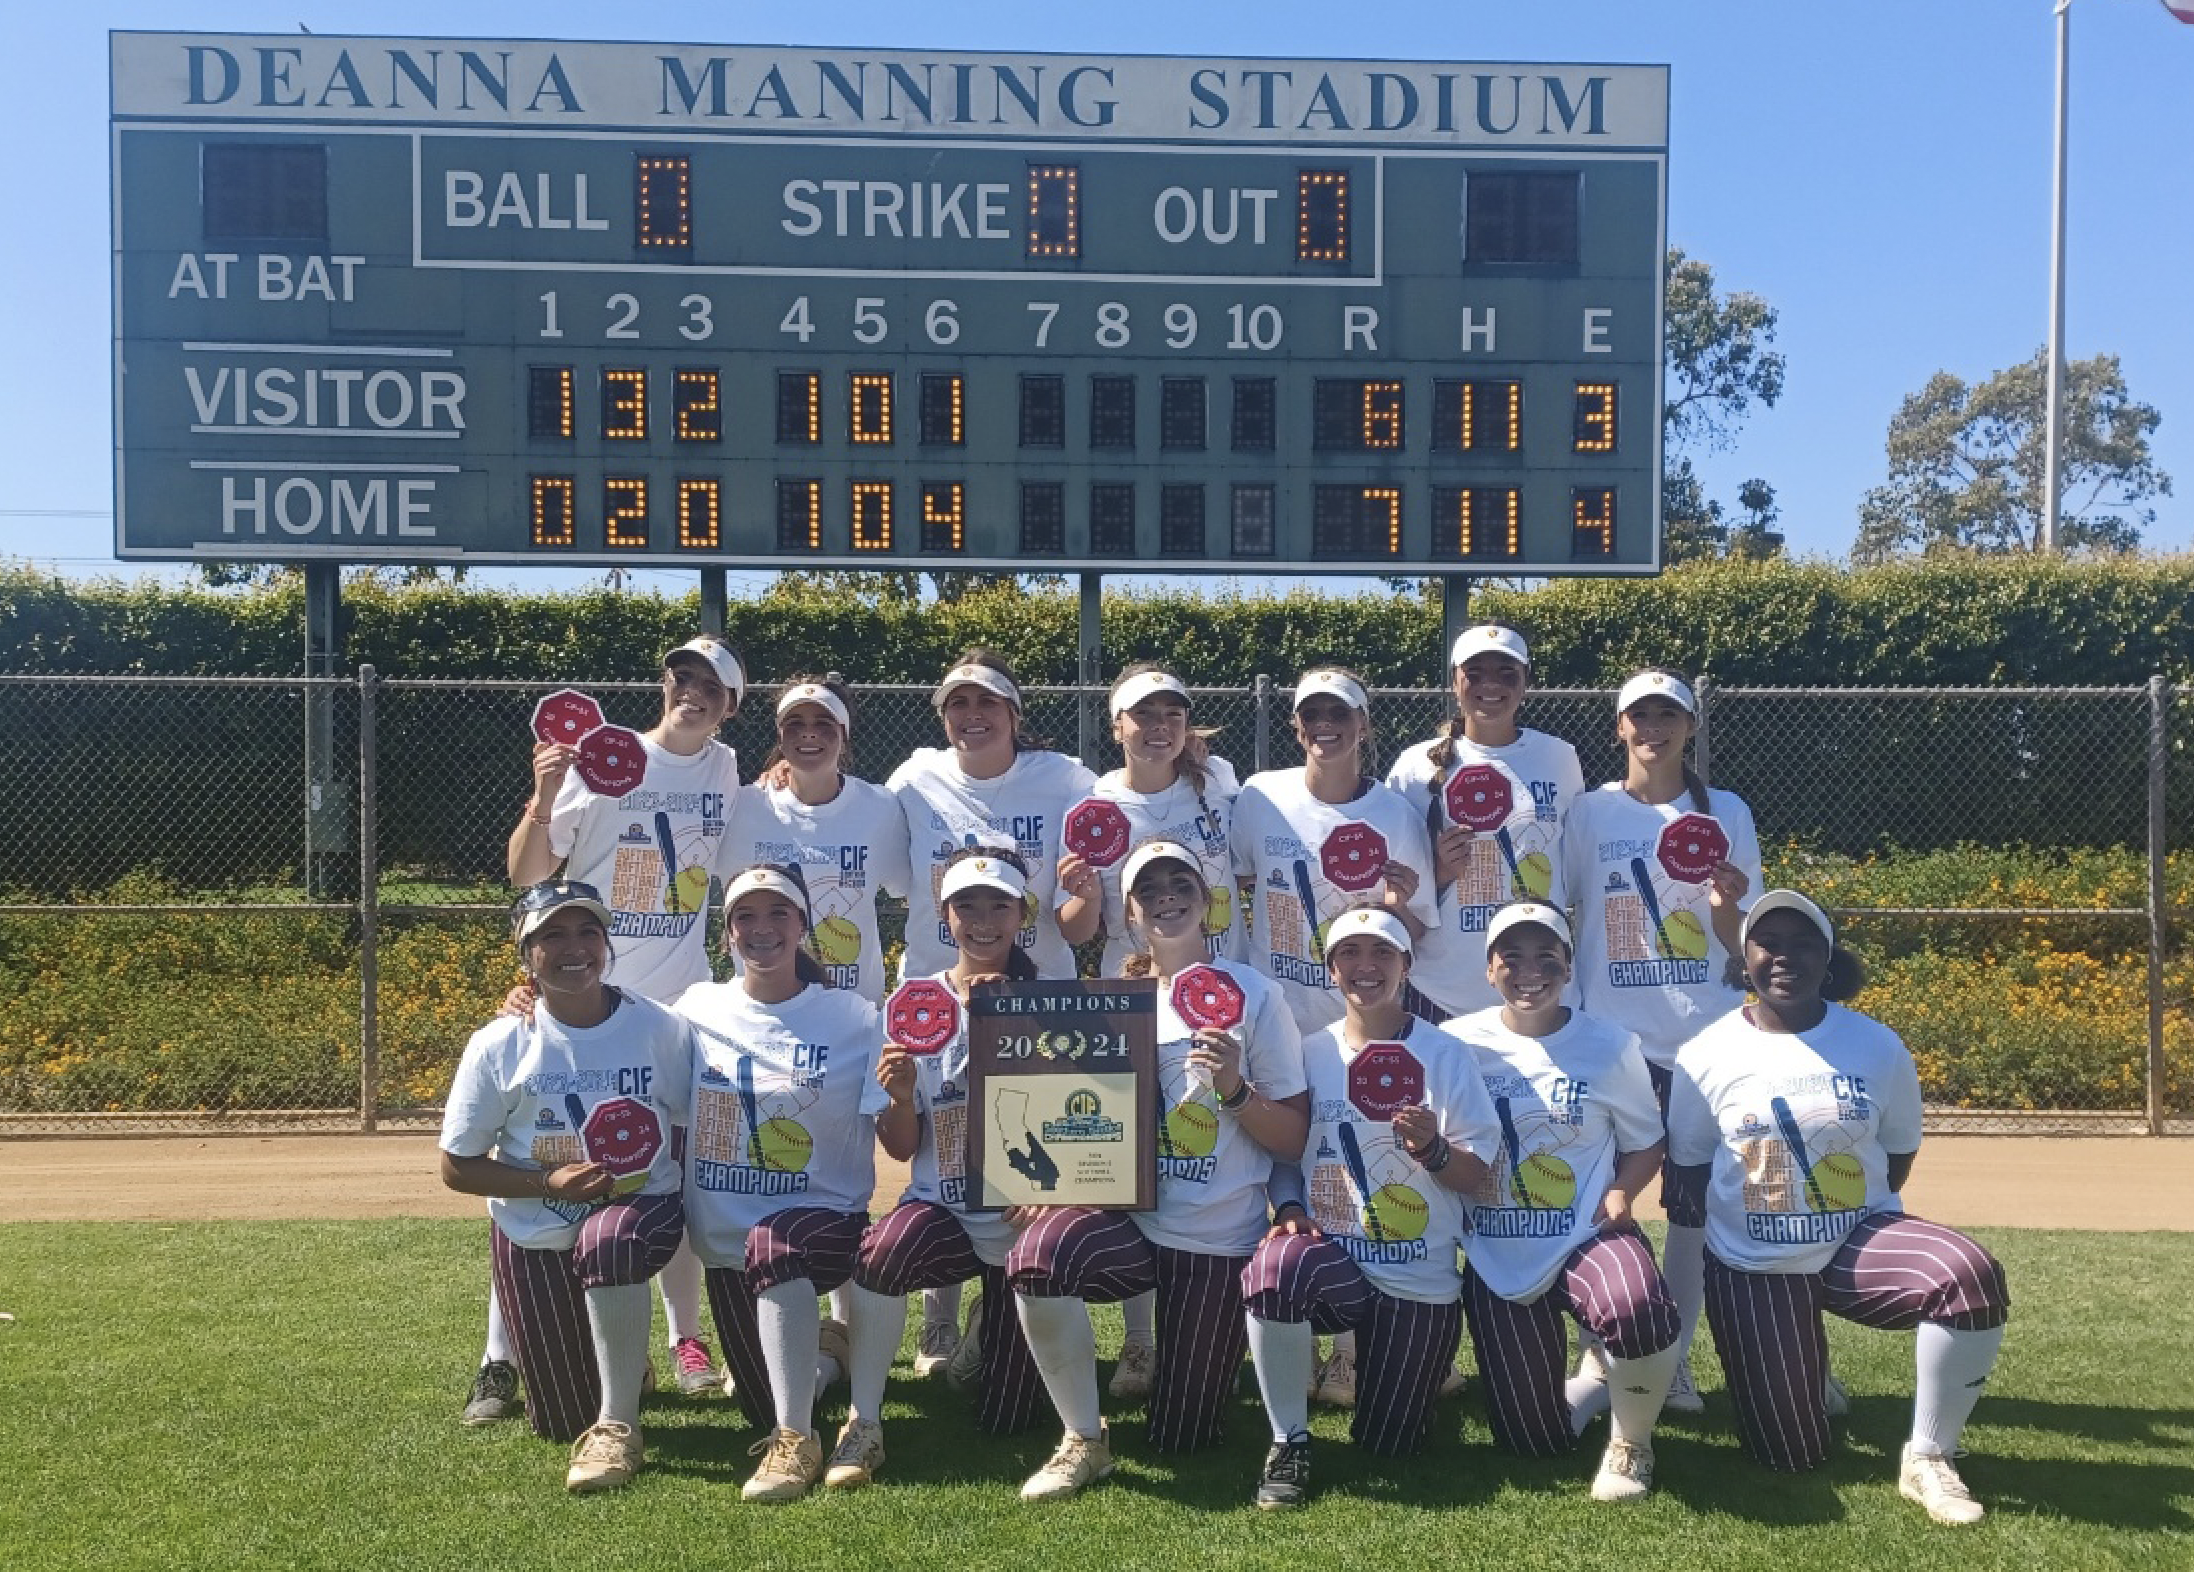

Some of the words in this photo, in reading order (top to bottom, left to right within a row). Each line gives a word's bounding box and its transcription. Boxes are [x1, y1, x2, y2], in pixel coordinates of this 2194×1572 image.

[183, 46, 585, 113] DEANNA
[657, 55, 1119, 126] MANNING
[1190, 70, 1612, 134] STADIUM
[446, 171, 609, 230] BALL
[639, 159, 690, 247] 0
[781, 180, 1010, 239] STRIKE
[1030, 167, 1077, 255] 0
[1155, 187, 1278, 244] OUT
[1300, 174, 1347, 260] 0
[168, 254, 238, 299] AT
[258, 255, 365, 301] BAT
[539, 292, 564, 337] 1
[605, 293, 640, 339] 2
[678, 295, 714, 341] 3
[780, 297, 815, 342] 4
[853, 298, 887, 343] 5
[925, 300, 960, 345] 6
[1027, 303, 1060, 347] 7
[1095, 303, 1131, 348] 8
[1163, 304, 1198, 349] 9
[1226, 305, 1282, 350] 10
[1344, 306, 1379, 351] R
[1462, 307, 1496, 352] H
[1583, 308, 1612, 353] E
[184, 368, 467, 430] VISITOR
[561, 368, 571, 438] 1
[605, 370, 645, 440] 3
[679, 373, 717, 440] 2
[808, 375, 818, 442] 1
[853, 375, 891, 442] 0
[952, 378, 962, 443] 1
[1461, 384, 1519, 450] 11
[1575, 385, 1613, 450] 3
[222, 477, 436, 536] HOME
[533, 479, 572, 544] 0
[606, 479, 646, 544] 2
[679, 480, 718, 545] 0
[809, 482, 820, 545] 1
[853, 484, 890, 547] 0
[925, 485, 962, 549] 4
[1363, 489, 1399, 553] 7
[1461, 490, 1518, 555] 11
[1575, 491, 1611, 554] 4
[702, 793, 724, 819] CIF
[1530, 781, 1558, 806] CIF
[1013, 815, 1044, 841] CIF
[841, 845, 868, 871] CIF
[1609, 959, 1709, 988] CHAMPIONS
[995, 995, 1131, 1013] CHAMPIONS
[793, 1043, 830, 1071] CIF
[997, 1035, 1033, 1059] 20
[1092, 1033, 1130, 1058] 24
[618, 1066, 654, 1095] CIF
[1550, 1077, 1588, 1105] CIF
[1832, 1075, 1867, 1101] CIF
[694, 1158, 810, 1197] CHAMPIONS
